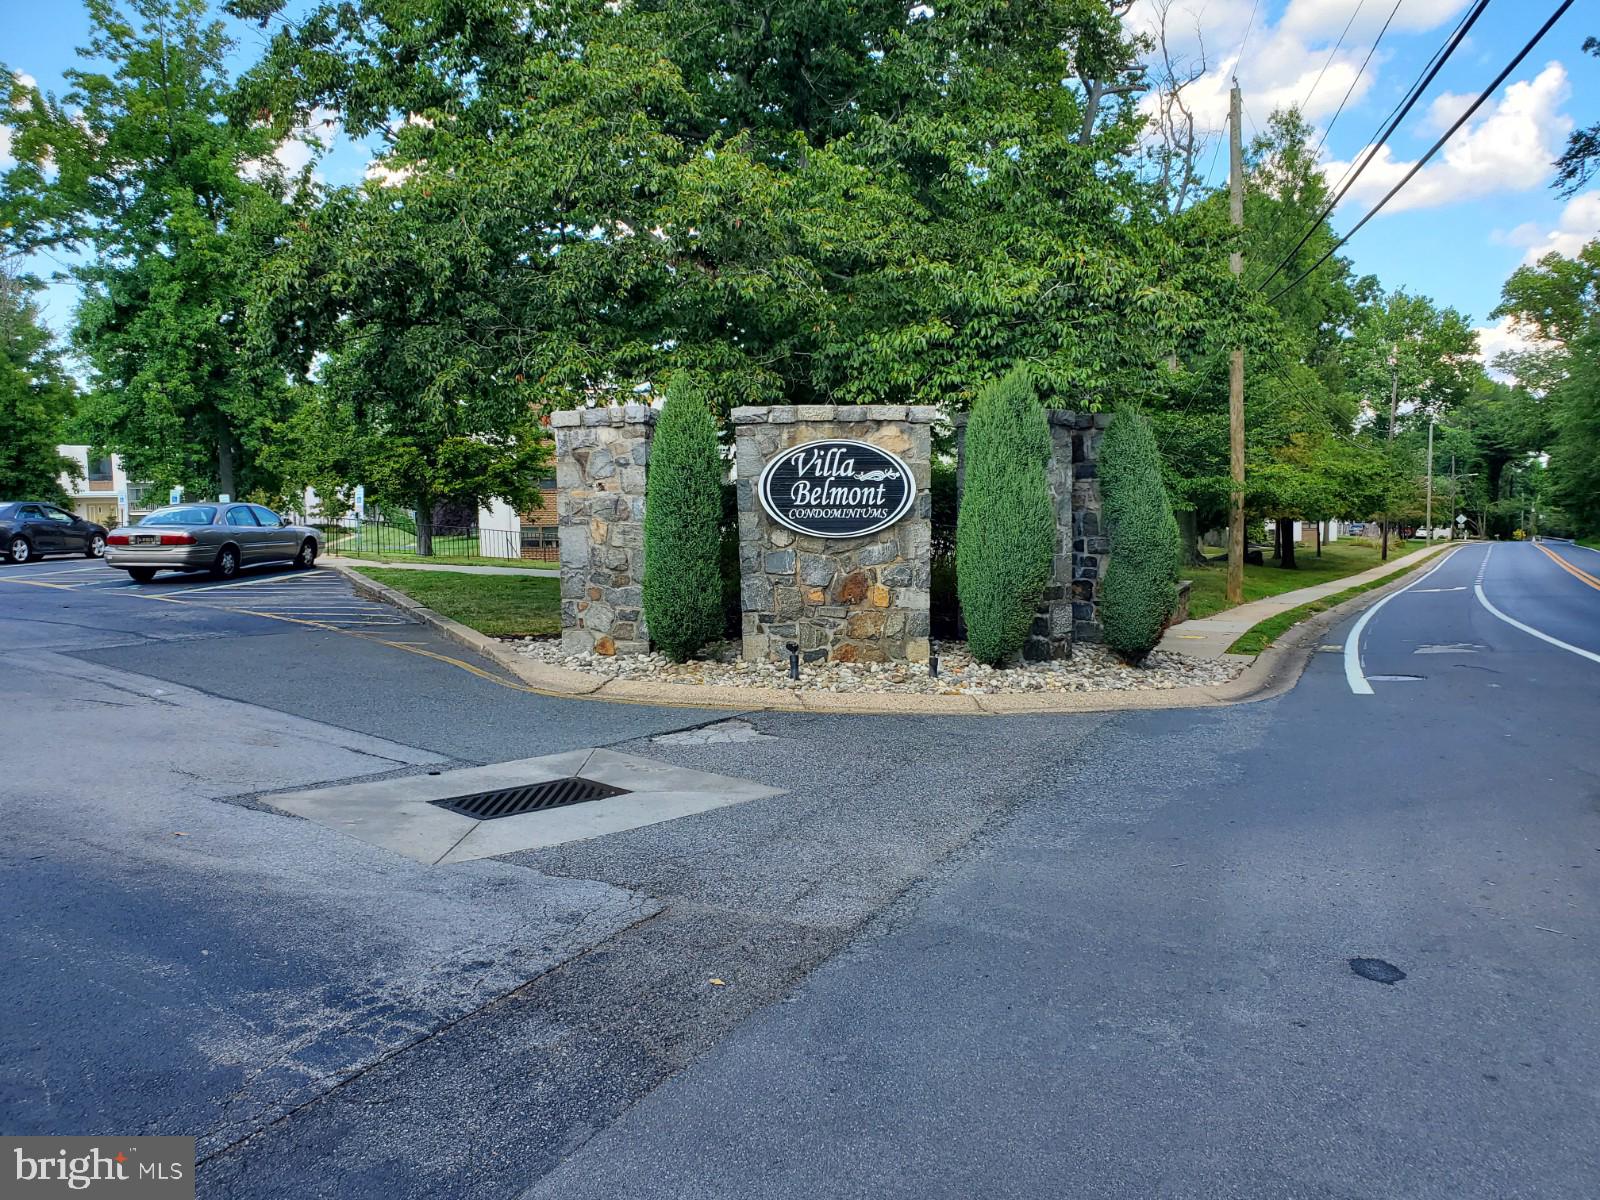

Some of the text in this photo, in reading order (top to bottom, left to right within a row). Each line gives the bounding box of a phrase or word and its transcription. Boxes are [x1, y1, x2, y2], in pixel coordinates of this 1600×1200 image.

[791, 448, 856, 478] Villa
[791, 477, 886, 506] Belmont
[788, 507, 888, 520] CONDOMINIUMS
